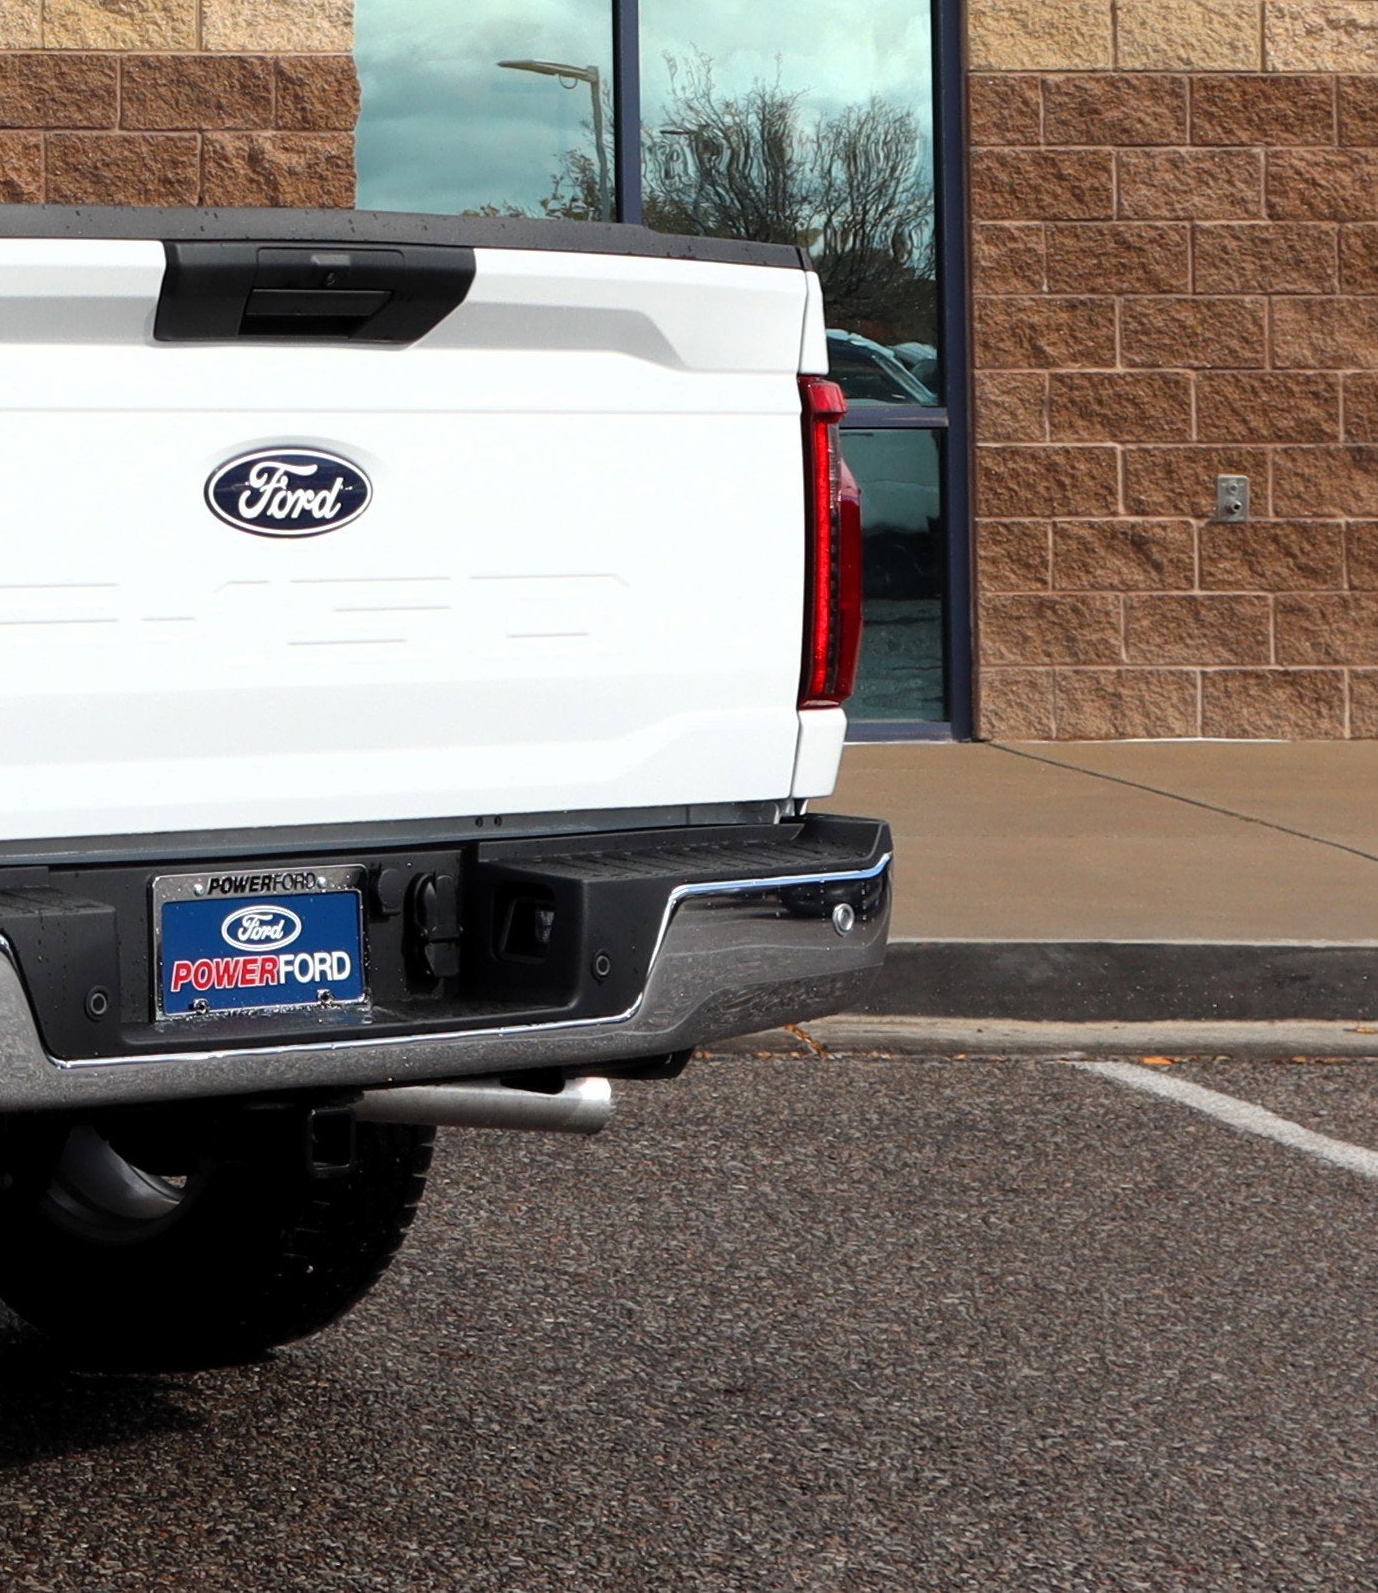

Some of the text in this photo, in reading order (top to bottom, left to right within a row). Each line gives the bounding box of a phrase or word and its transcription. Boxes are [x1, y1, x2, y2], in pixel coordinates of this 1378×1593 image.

[238, 460, 344, 520] Ford
[207, 872, 317, 895] POWERFORD
[237, 913, 284, 941] Ford
[170, 950, 351, 993] POWERFORD
